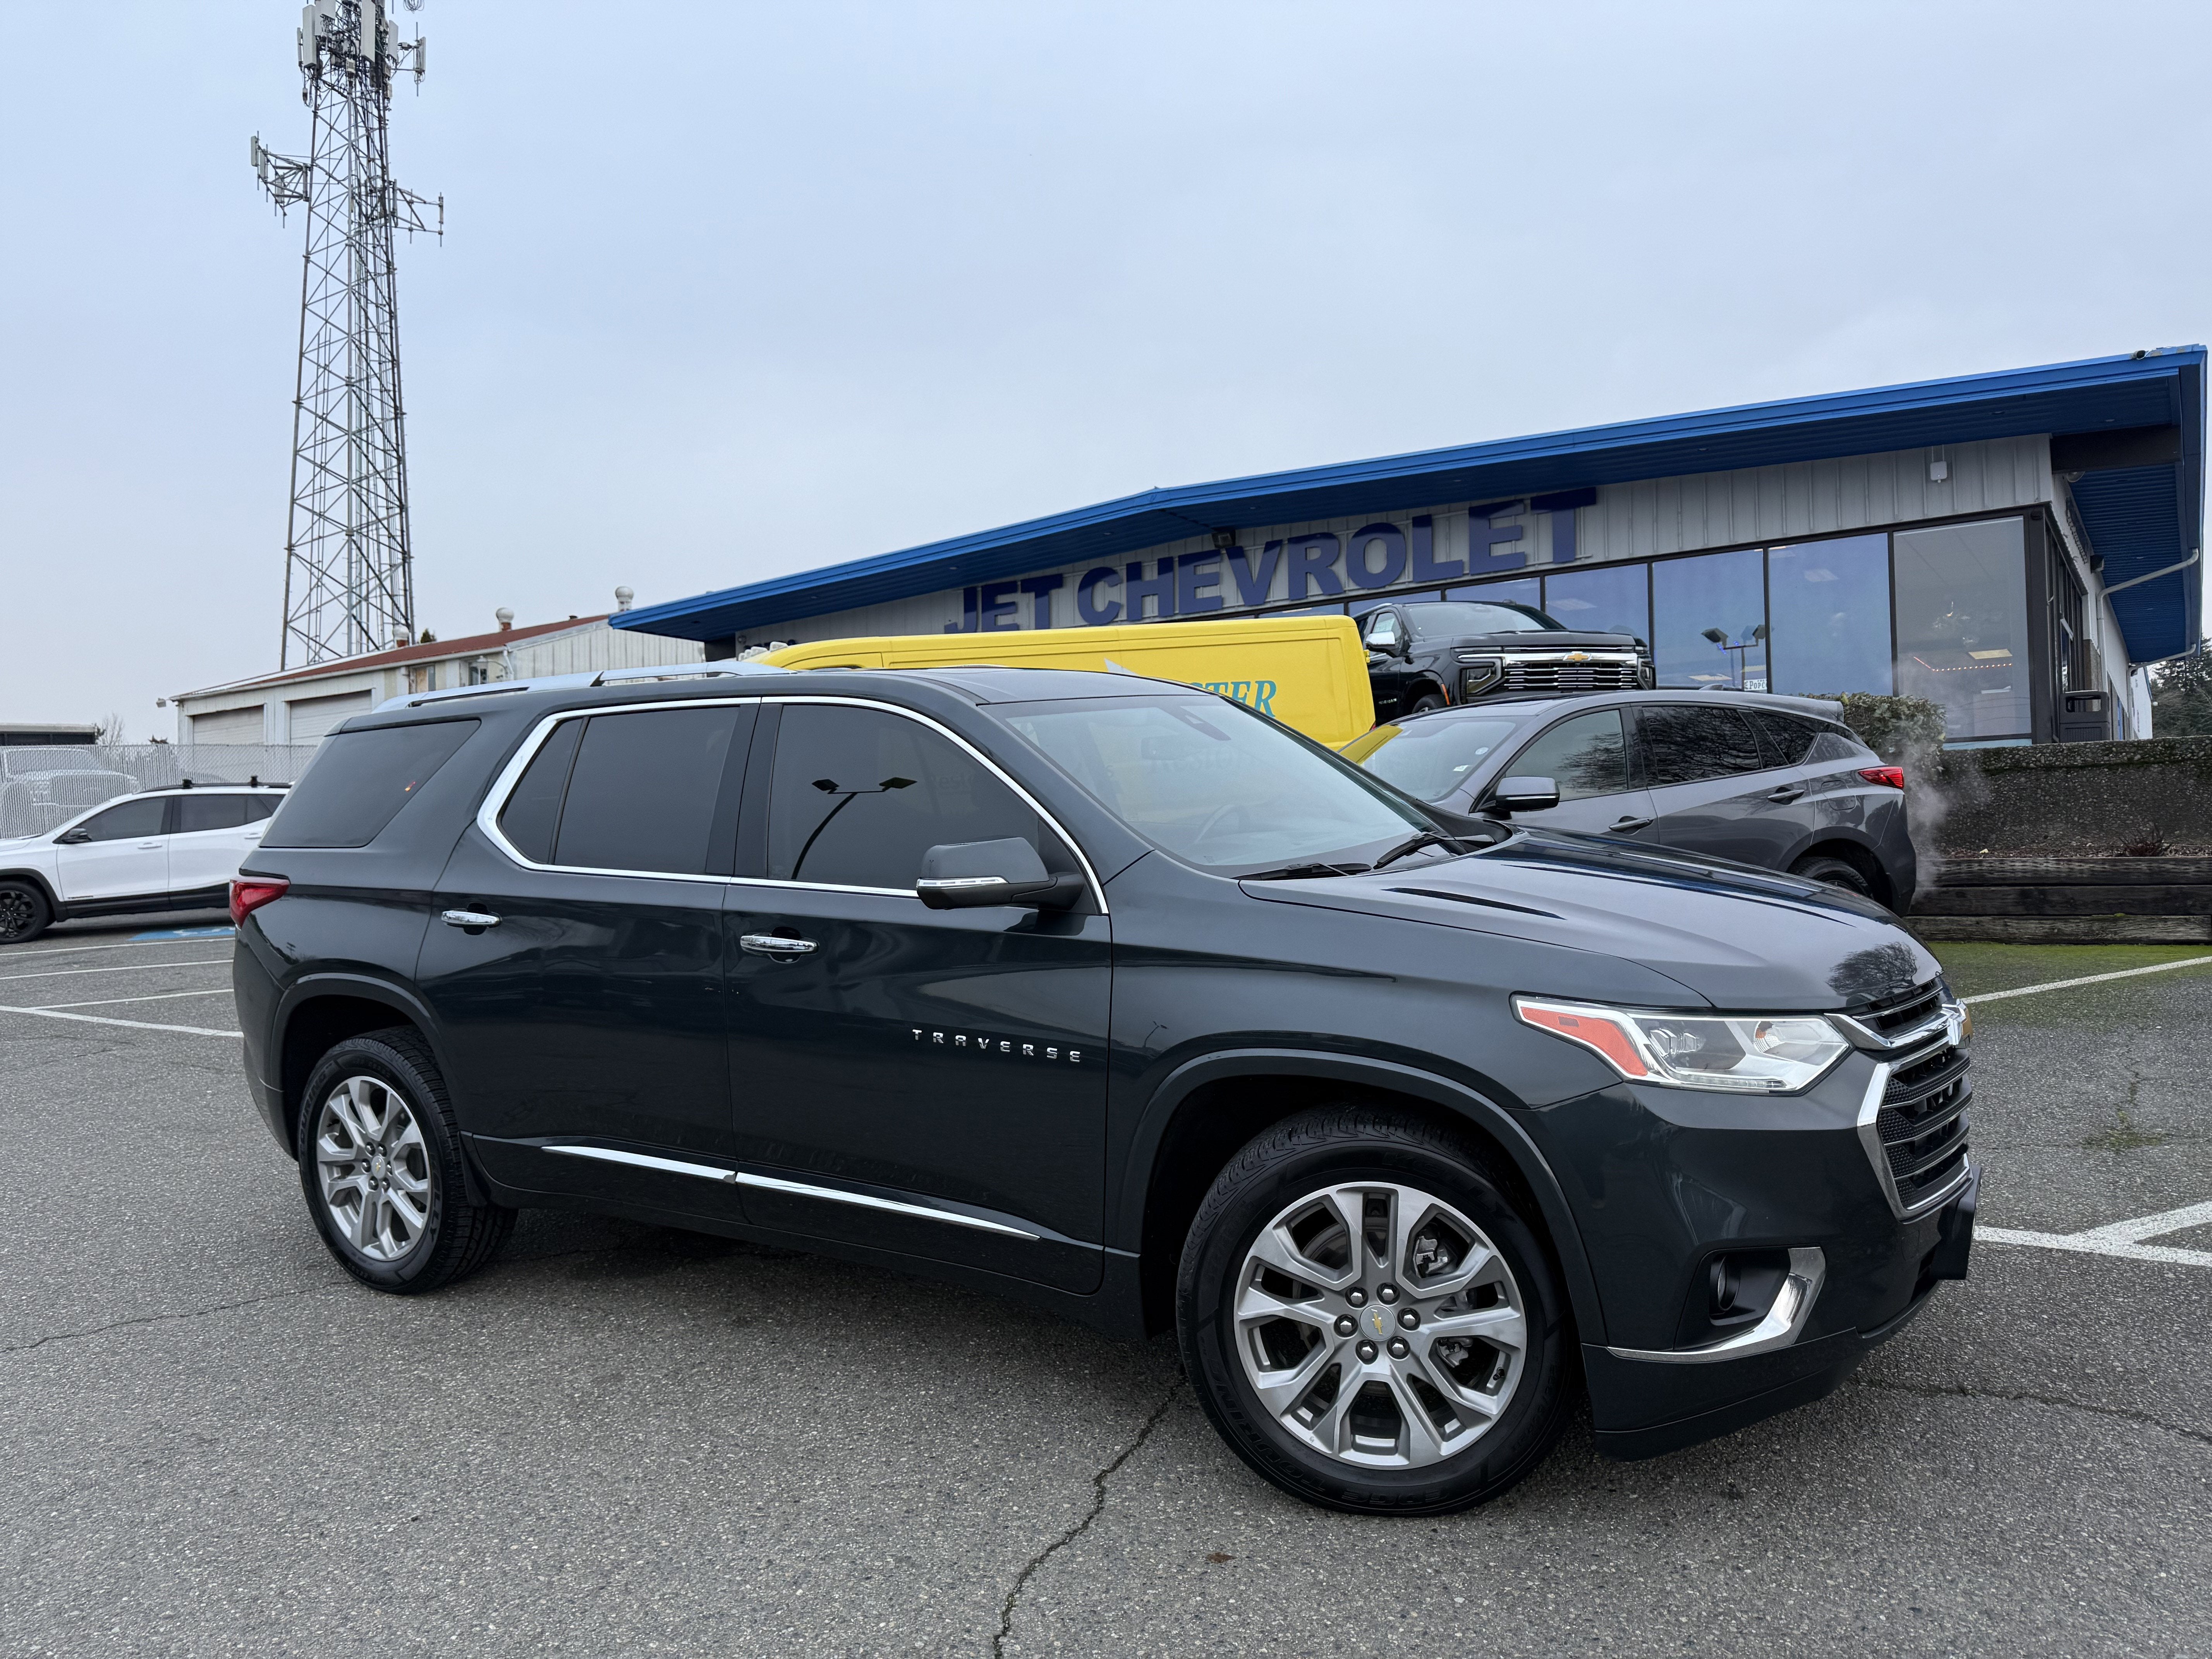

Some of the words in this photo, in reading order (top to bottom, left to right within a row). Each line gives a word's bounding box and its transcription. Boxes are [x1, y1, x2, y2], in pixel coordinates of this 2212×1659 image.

[944, 573, 1063, 634] JET
[1077, 487, 1596, 627] CHEVROLET
[912, 1029, 1080, 1063] TRAVERSE
